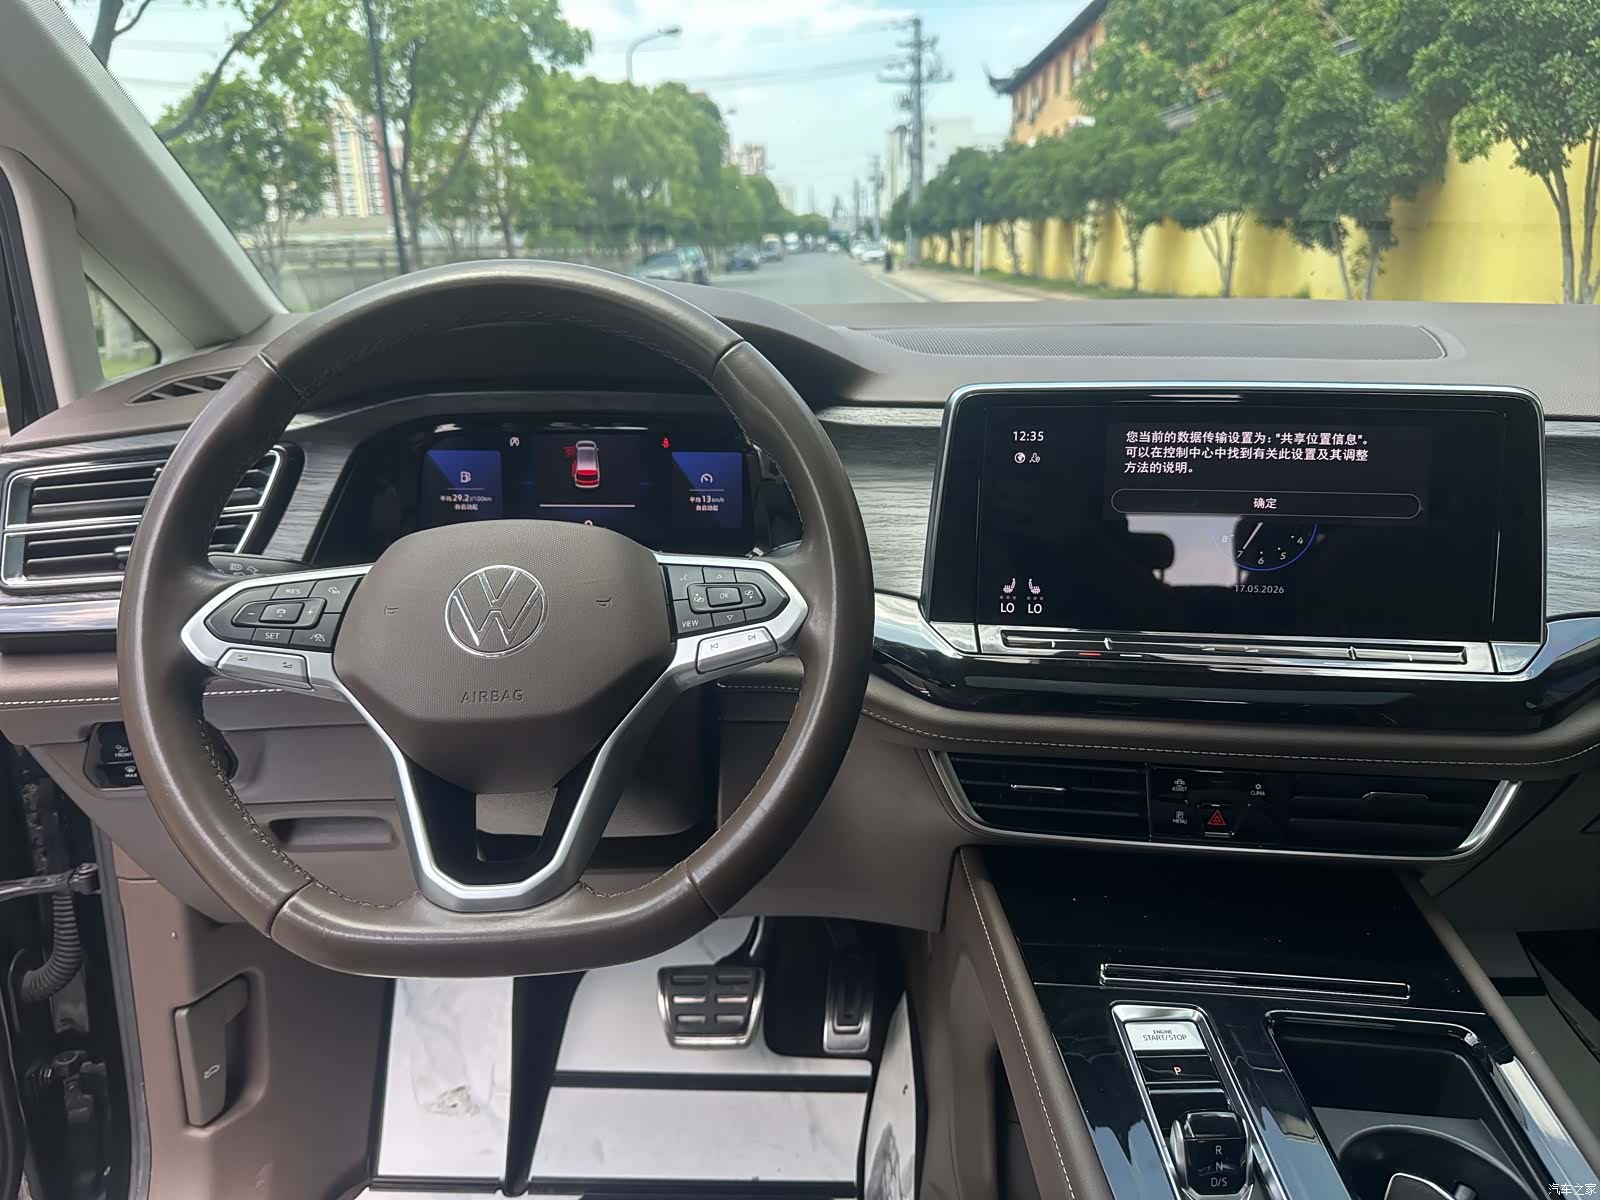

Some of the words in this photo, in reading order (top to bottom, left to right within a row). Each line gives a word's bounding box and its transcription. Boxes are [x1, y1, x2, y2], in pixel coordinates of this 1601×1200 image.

[1013, 431, 1044, 442] 12:35
[1125, 446, 1369, 462] 可以在控制中心中找到有关此设置及其调整
[1123, 461, 1194, 474] 方法的说明。
[1253, 497, 1277, 509] 确定
[1221, 535, 1229, 544] 8
[1296, 536, 1304, 545] 4
[1237, 550, 1244, 559] 7
[1280, 551, 1287, 560] 5
[1257, 556, 1265, 565] 6
[285, 587, 302, 596] RES
[1235, 584, 1285, 594] 17.05.2026
[719, 592, 729, 600] OK
[1000, 602, 1015, 613] LO
[1028, 603, 1043, 614] LO
[681, 619, 699, 628] VIEW
[265, 632, 280, 640] SET
[461, 689, 524, 704] AIRBAG
[1173, 1066, 1182, 1076] P
[1215, 1145, 1223, 1156] R
[1215, 1162, 1223, 1171] N
[1210, 1177, 1228, 1188] D/S
